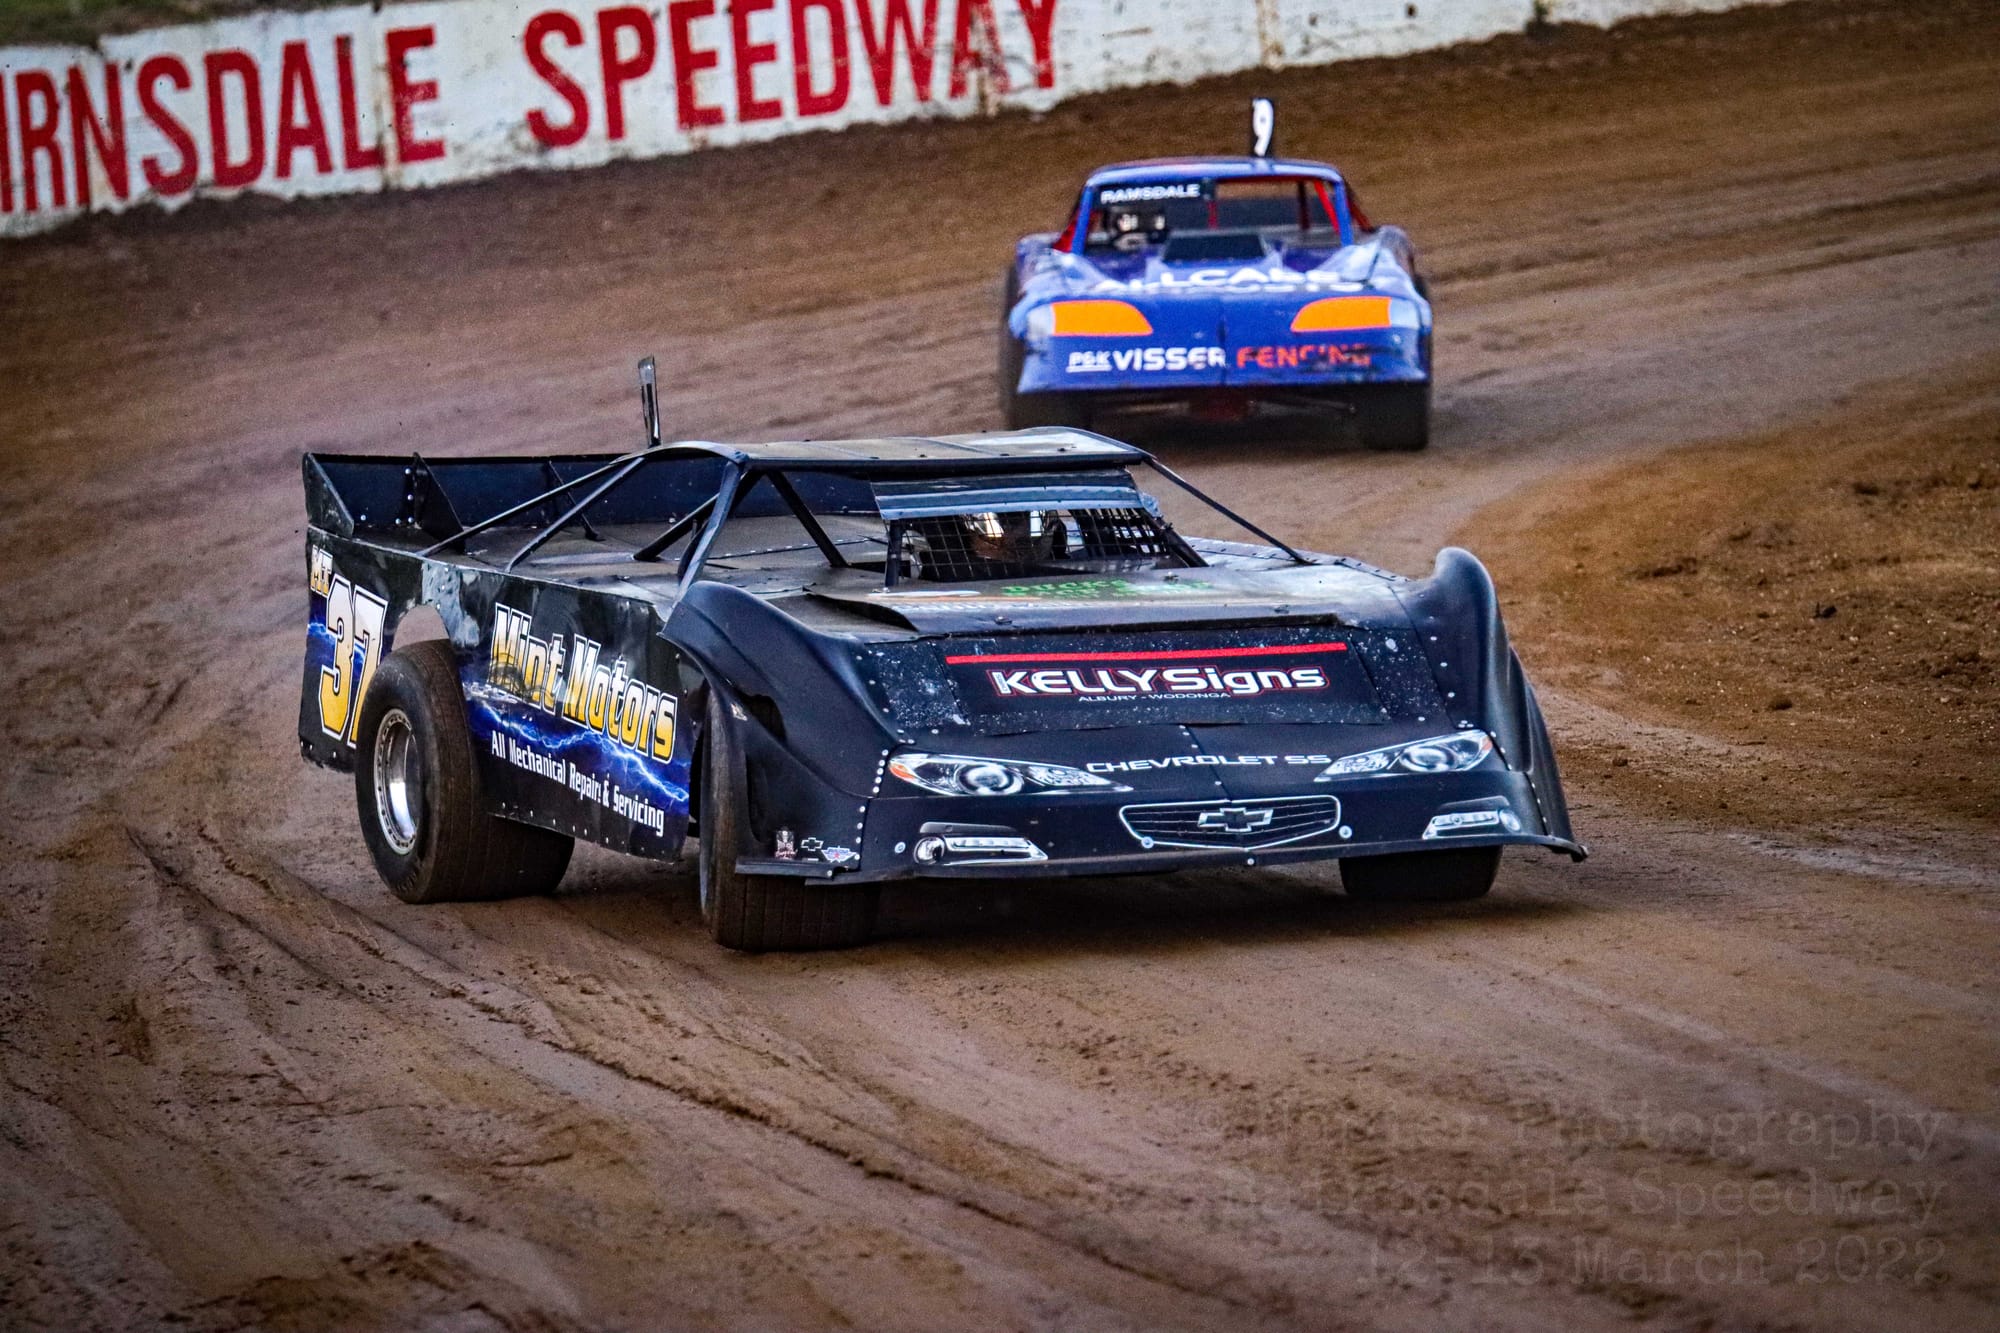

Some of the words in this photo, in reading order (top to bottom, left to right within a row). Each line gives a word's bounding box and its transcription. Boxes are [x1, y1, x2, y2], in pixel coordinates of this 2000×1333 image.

[523, 0, 1057, 148] SPEEDWAY
[1113, 347, 1226, 371] VISSER
[318, 573, 389, 749] 37
[487, 602, 566, 715] Mint
[563, 633, 678, 764] Motors
[1079, 694, 1136, 702] ALBURY
[1149, 692, 1231, 700] WODONGA
[491, 730, 506, 760] All
[509, 737, 566, 785] Mechanical
[602, 779, 610, 809] &
[613, 785, 664, 837] Servicing
[1086, 755, 1280, 773] CHEVROLET
[1283, 754, 1332, 765] SS
